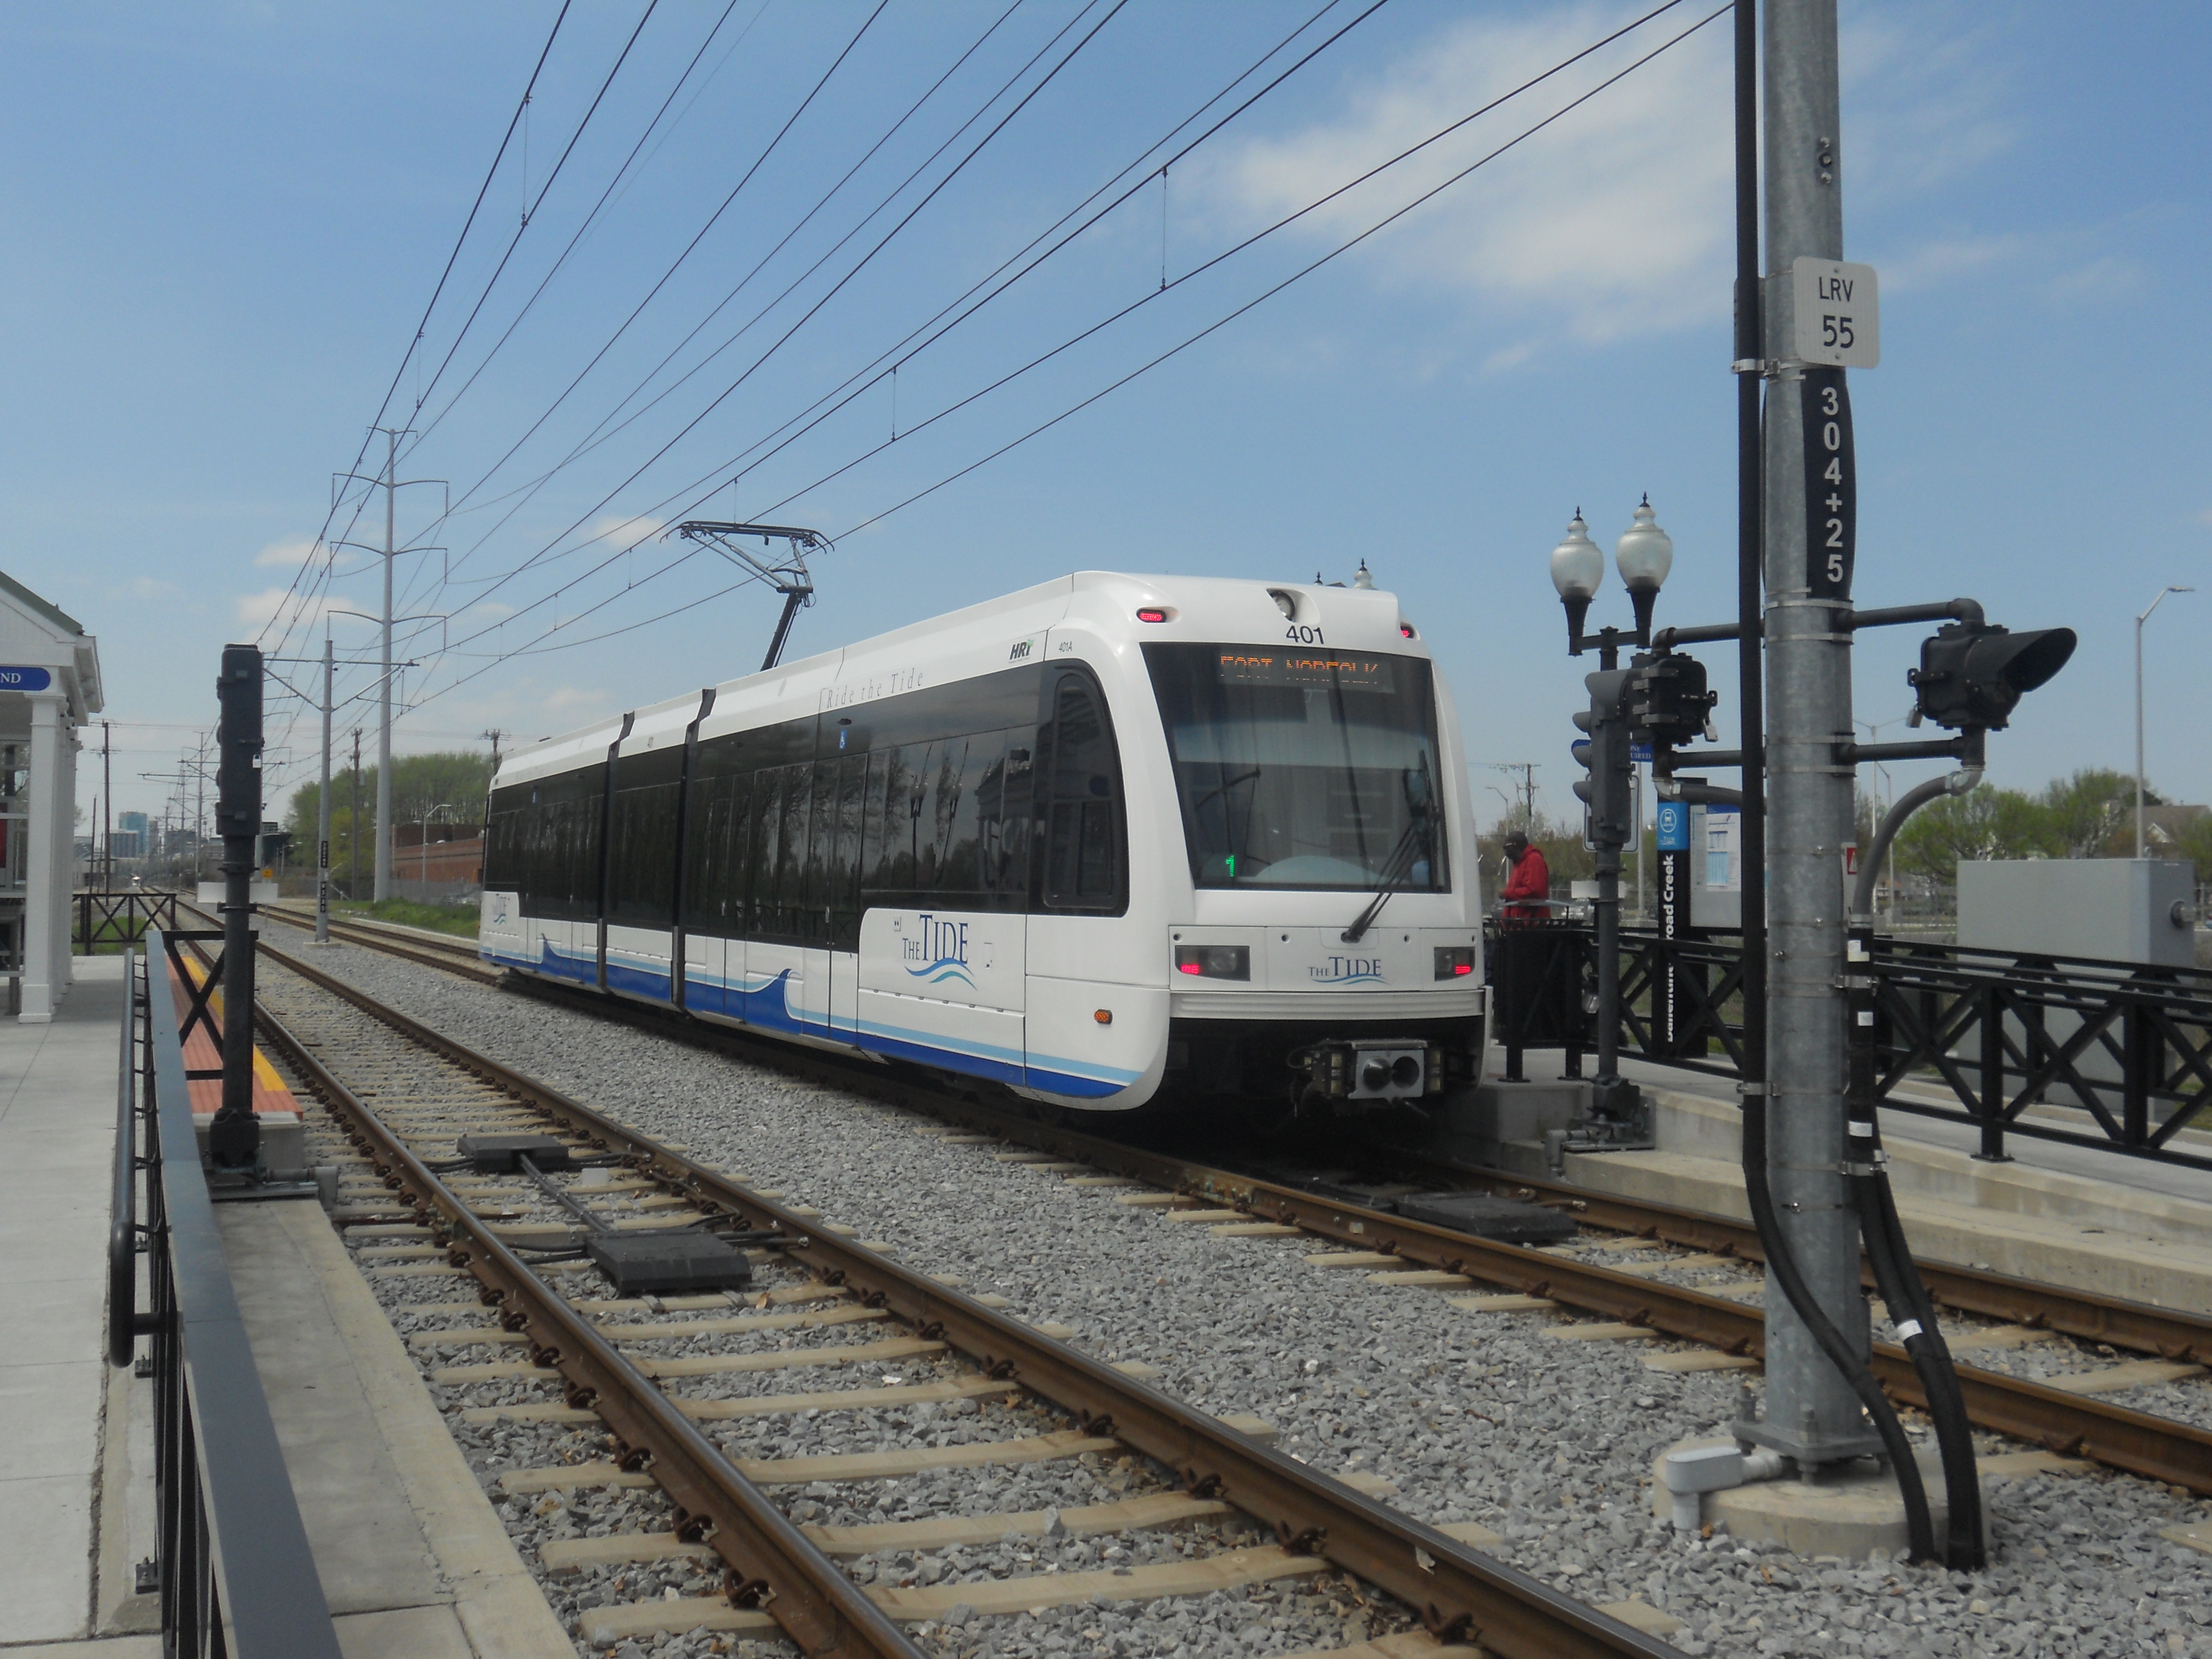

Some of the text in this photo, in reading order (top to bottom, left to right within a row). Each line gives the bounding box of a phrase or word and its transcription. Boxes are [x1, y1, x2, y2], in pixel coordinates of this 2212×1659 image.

[1819, 276, 1854, 302] LRV
[1823, 315, 1854, 348] 55
[1059, 641, 1072, 652] 401A
[1286, 625, 1324, 644] 401
[827, 667, 922, 708] Ride the Tide
[1663, 854, 1674, 902] Creek
[902, 914, 968, 964] THE TIDE
[1663, 905, 1674, 940] road
[1308, 957, 1382, 976] THE TIDE
